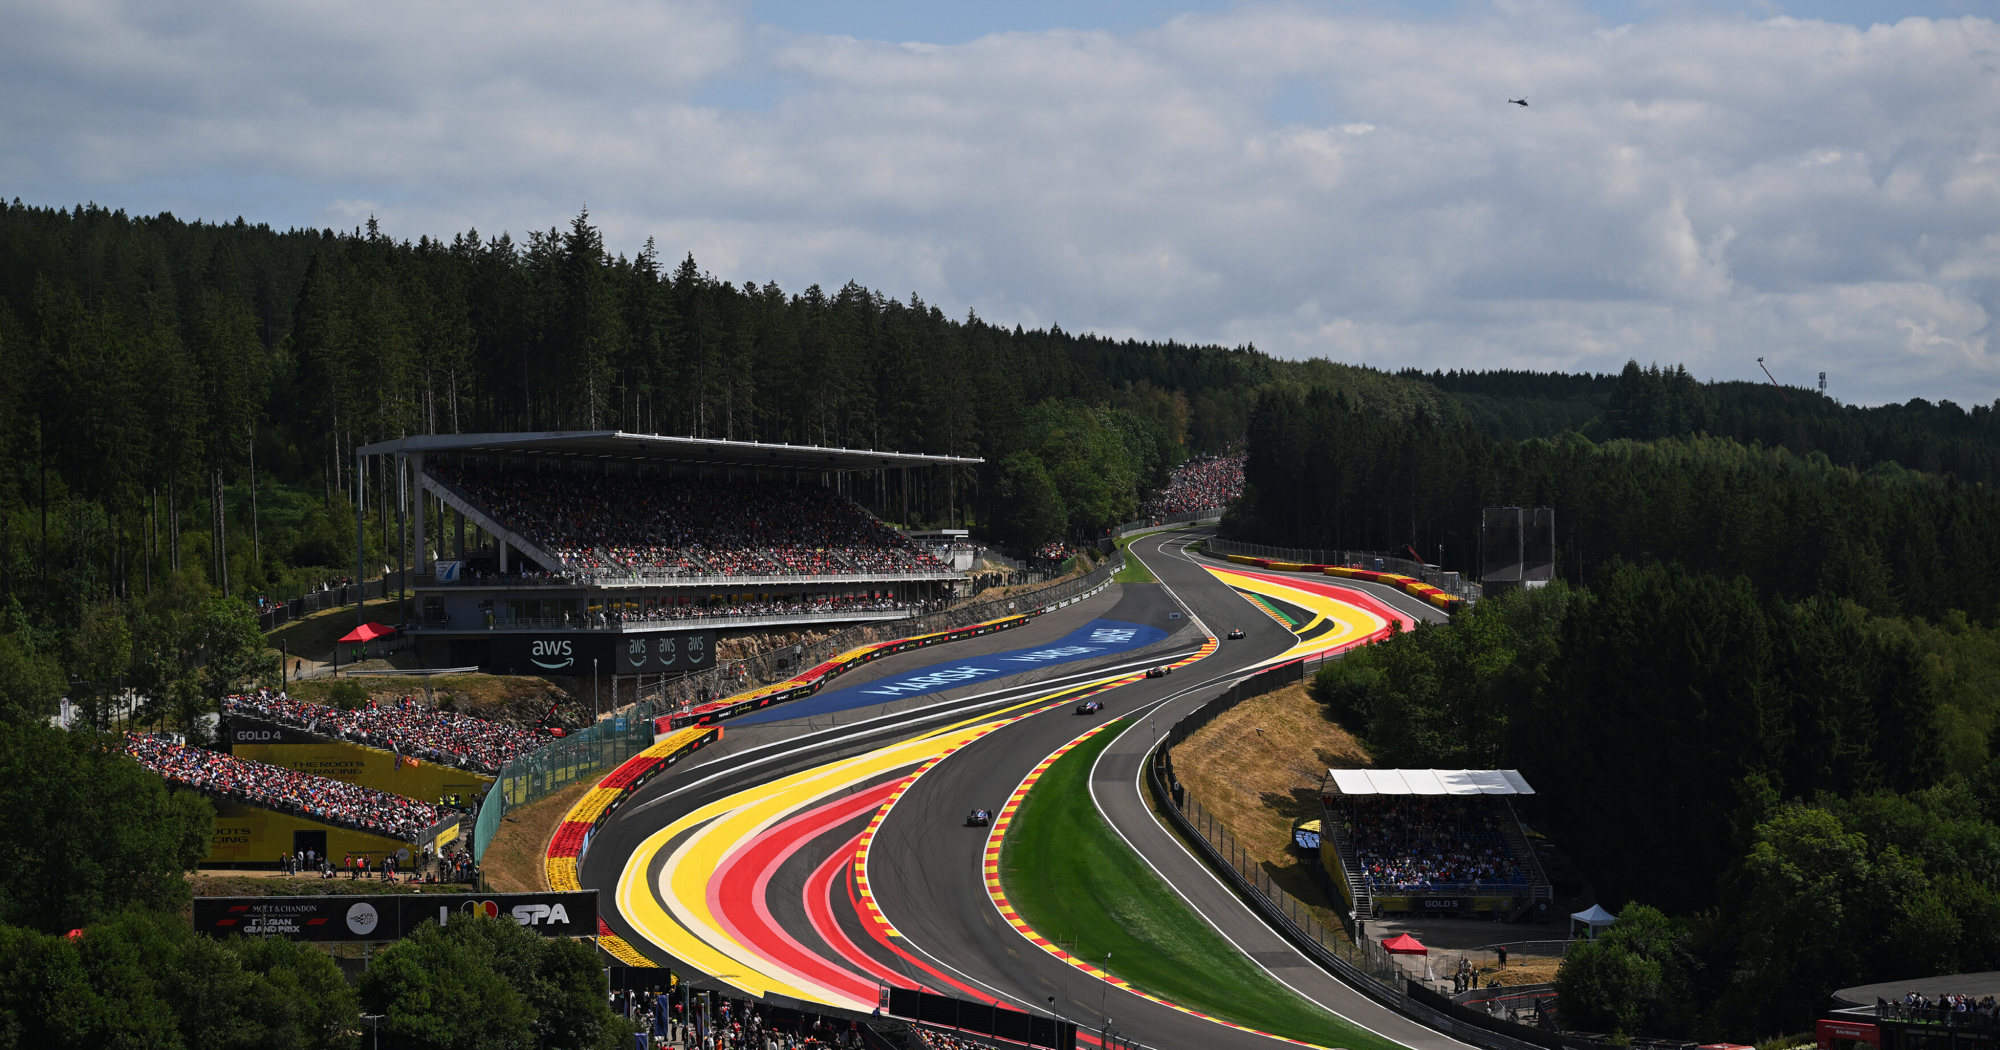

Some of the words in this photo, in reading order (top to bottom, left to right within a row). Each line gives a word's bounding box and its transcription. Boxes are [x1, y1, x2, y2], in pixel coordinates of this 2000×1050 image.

[532, 640, 572, 656] aws
[629, 638, 646, 654] aws
[659, 637, 676, 653] aws
[688, 636, 704, 651] aws
[860, 666, 999, 695] MARSH
[237, 731, 271, 741] GOLD
[273, 731, 282, 741] 4
[1425, 900, 1451, 908] GOLD
[1452, 900, 1458, 908] 5
[512, 903, 570, 926] SPA
[278, 925, 300, 933] PRIX
